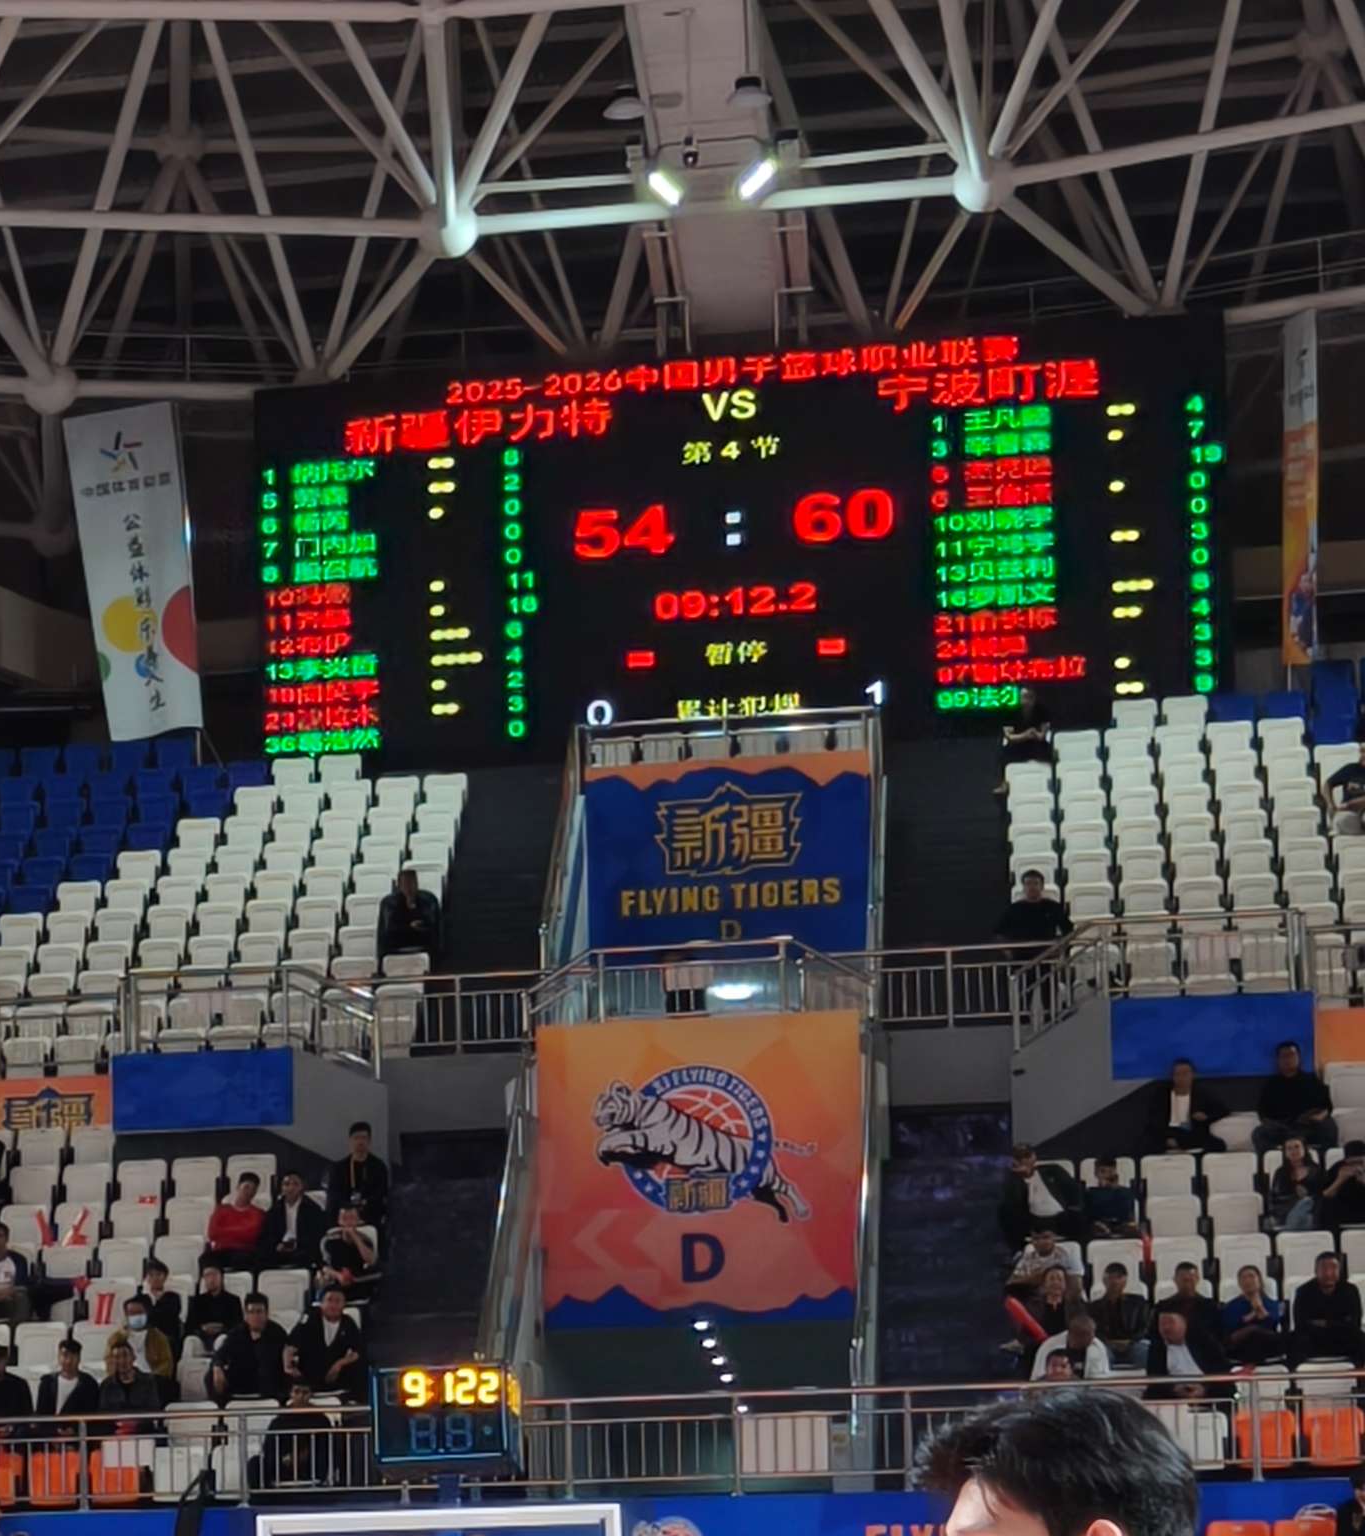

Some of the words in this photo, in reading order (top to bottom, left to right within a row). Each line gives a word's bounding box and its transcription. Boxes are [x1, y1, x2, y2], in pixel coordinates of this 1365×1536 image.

[447, 336, 1018, 403] 2025-2026中国男子篮球职业联赛
[702, 389, 757, 421] VS
[344, 399, 612, 453] 新疆伊力特
[1187, 419, 1205, 438] 7
[720, 443, 741, 460] 4
[503, 472, 521, 492] 2
[1188, 471, 1206, 490] 0
[1190, 496, 1207, 515] 0
[574, 505, 676, 559] 54
[792, 488, 895, 543] 60
[262, 541, 279, 559] 7
[509, 571, 536, 590] 11
[653, 582, 817, 621] 09:12.2
[706, 639, 768, 666] 暂停
[507, 669, 525, 688] 2
[508, 694, 525, 713] 3
[865, 680, 884, 705] 1
[586, 699, 614, 726] 0
[671, 801, 788, 868] 新疆
[620, 886, 720, 917] FLYING
[730, 877, 841, 909] TIGERS
[720, 919, 742, 941] D
[671, 1066, 727, 1089] FLYING
[680, 1232, 726, 1284] D
